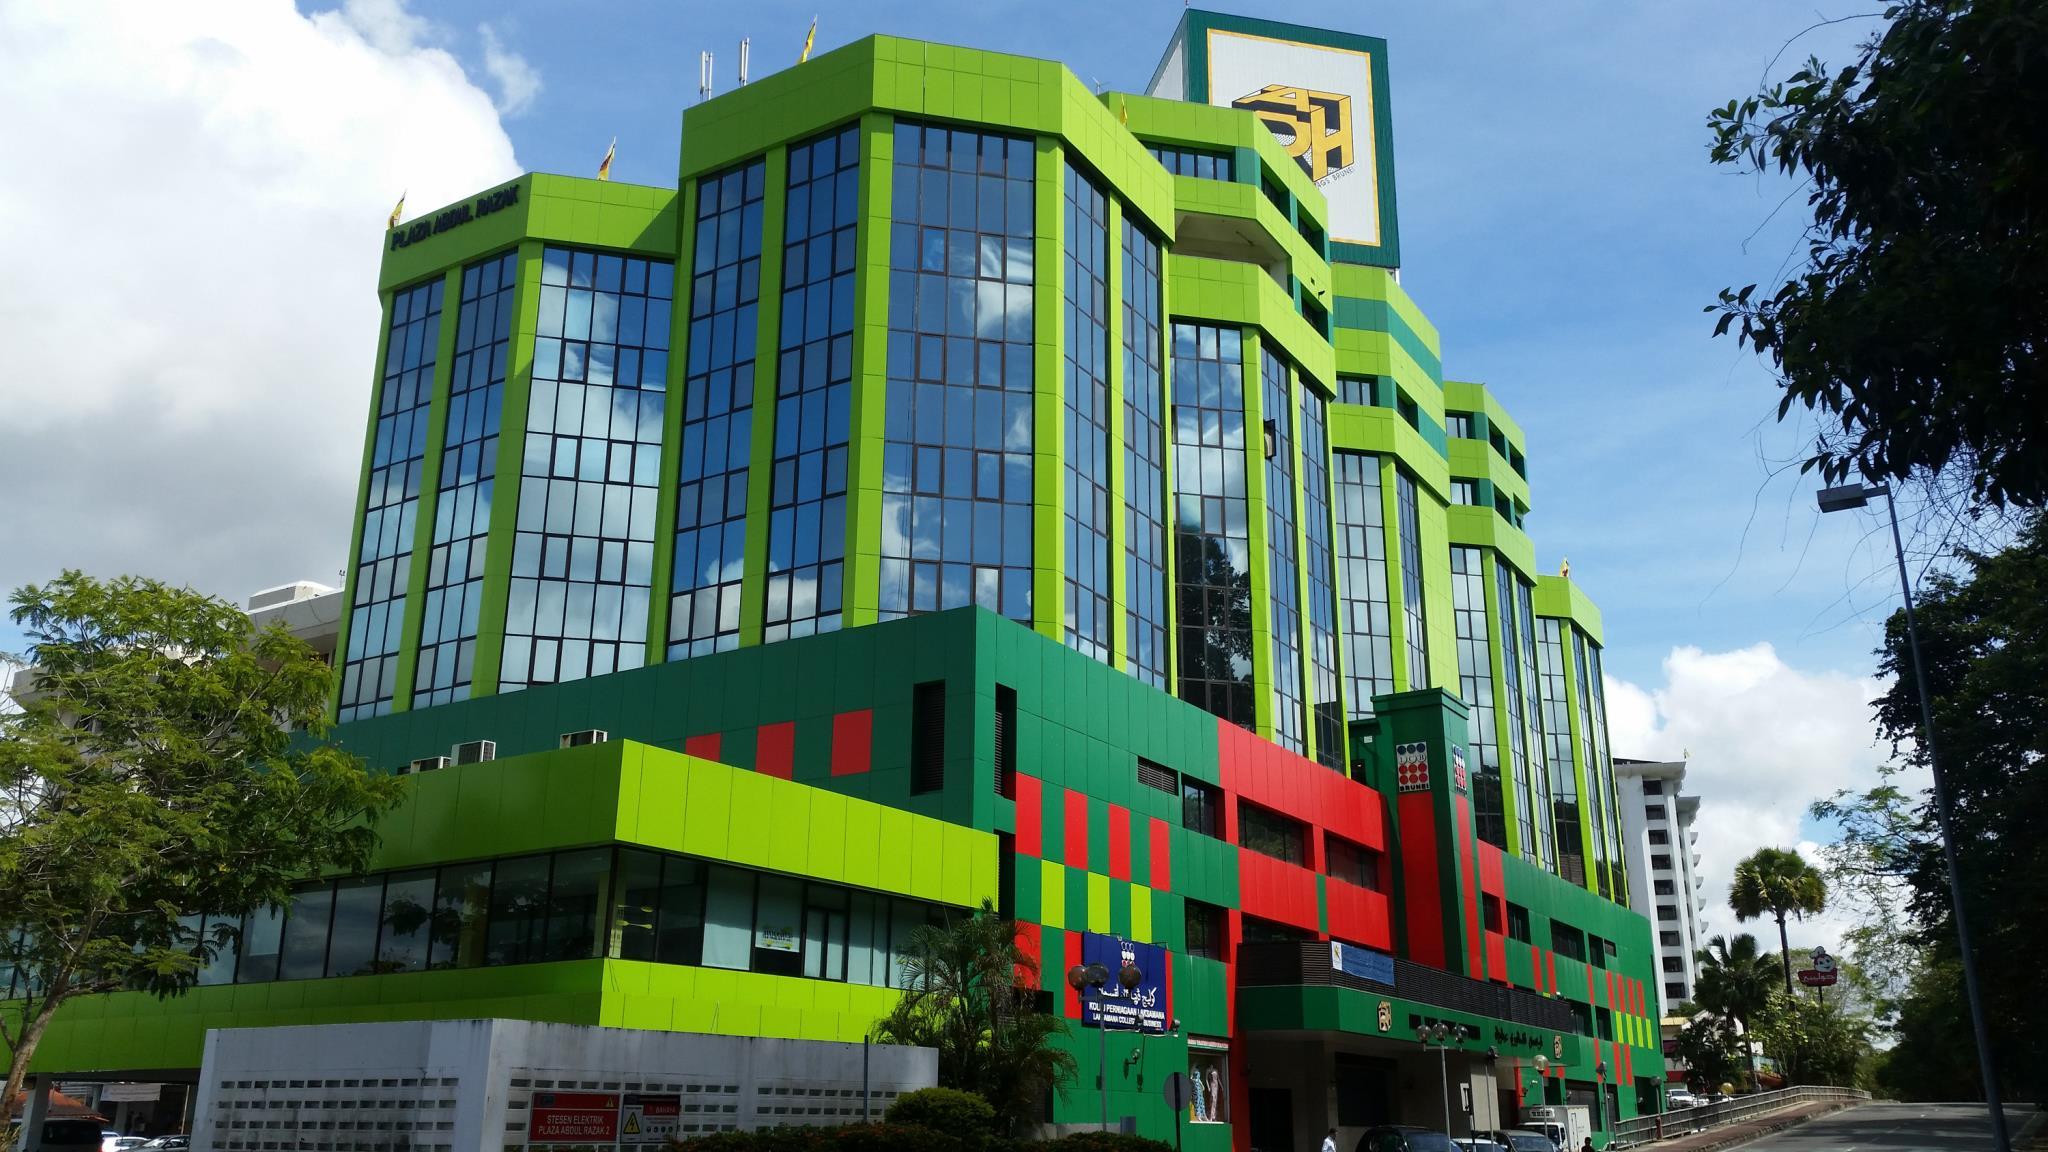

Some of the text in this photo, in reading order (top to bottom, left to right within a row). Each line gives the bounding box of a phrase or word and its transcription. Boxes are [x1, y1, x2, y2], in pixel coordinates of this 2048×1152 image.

[391, 184, 520, 251] PLAZA ABDUL RAZAK
[547, 1114, 604, 1125] STESEN ELEKTRIK
[538, 1125, 560, 1135] PLAZA
[560, 1126, 583, 1136] ABDUL
[583, 1126, 605, 1136] RAZAK
